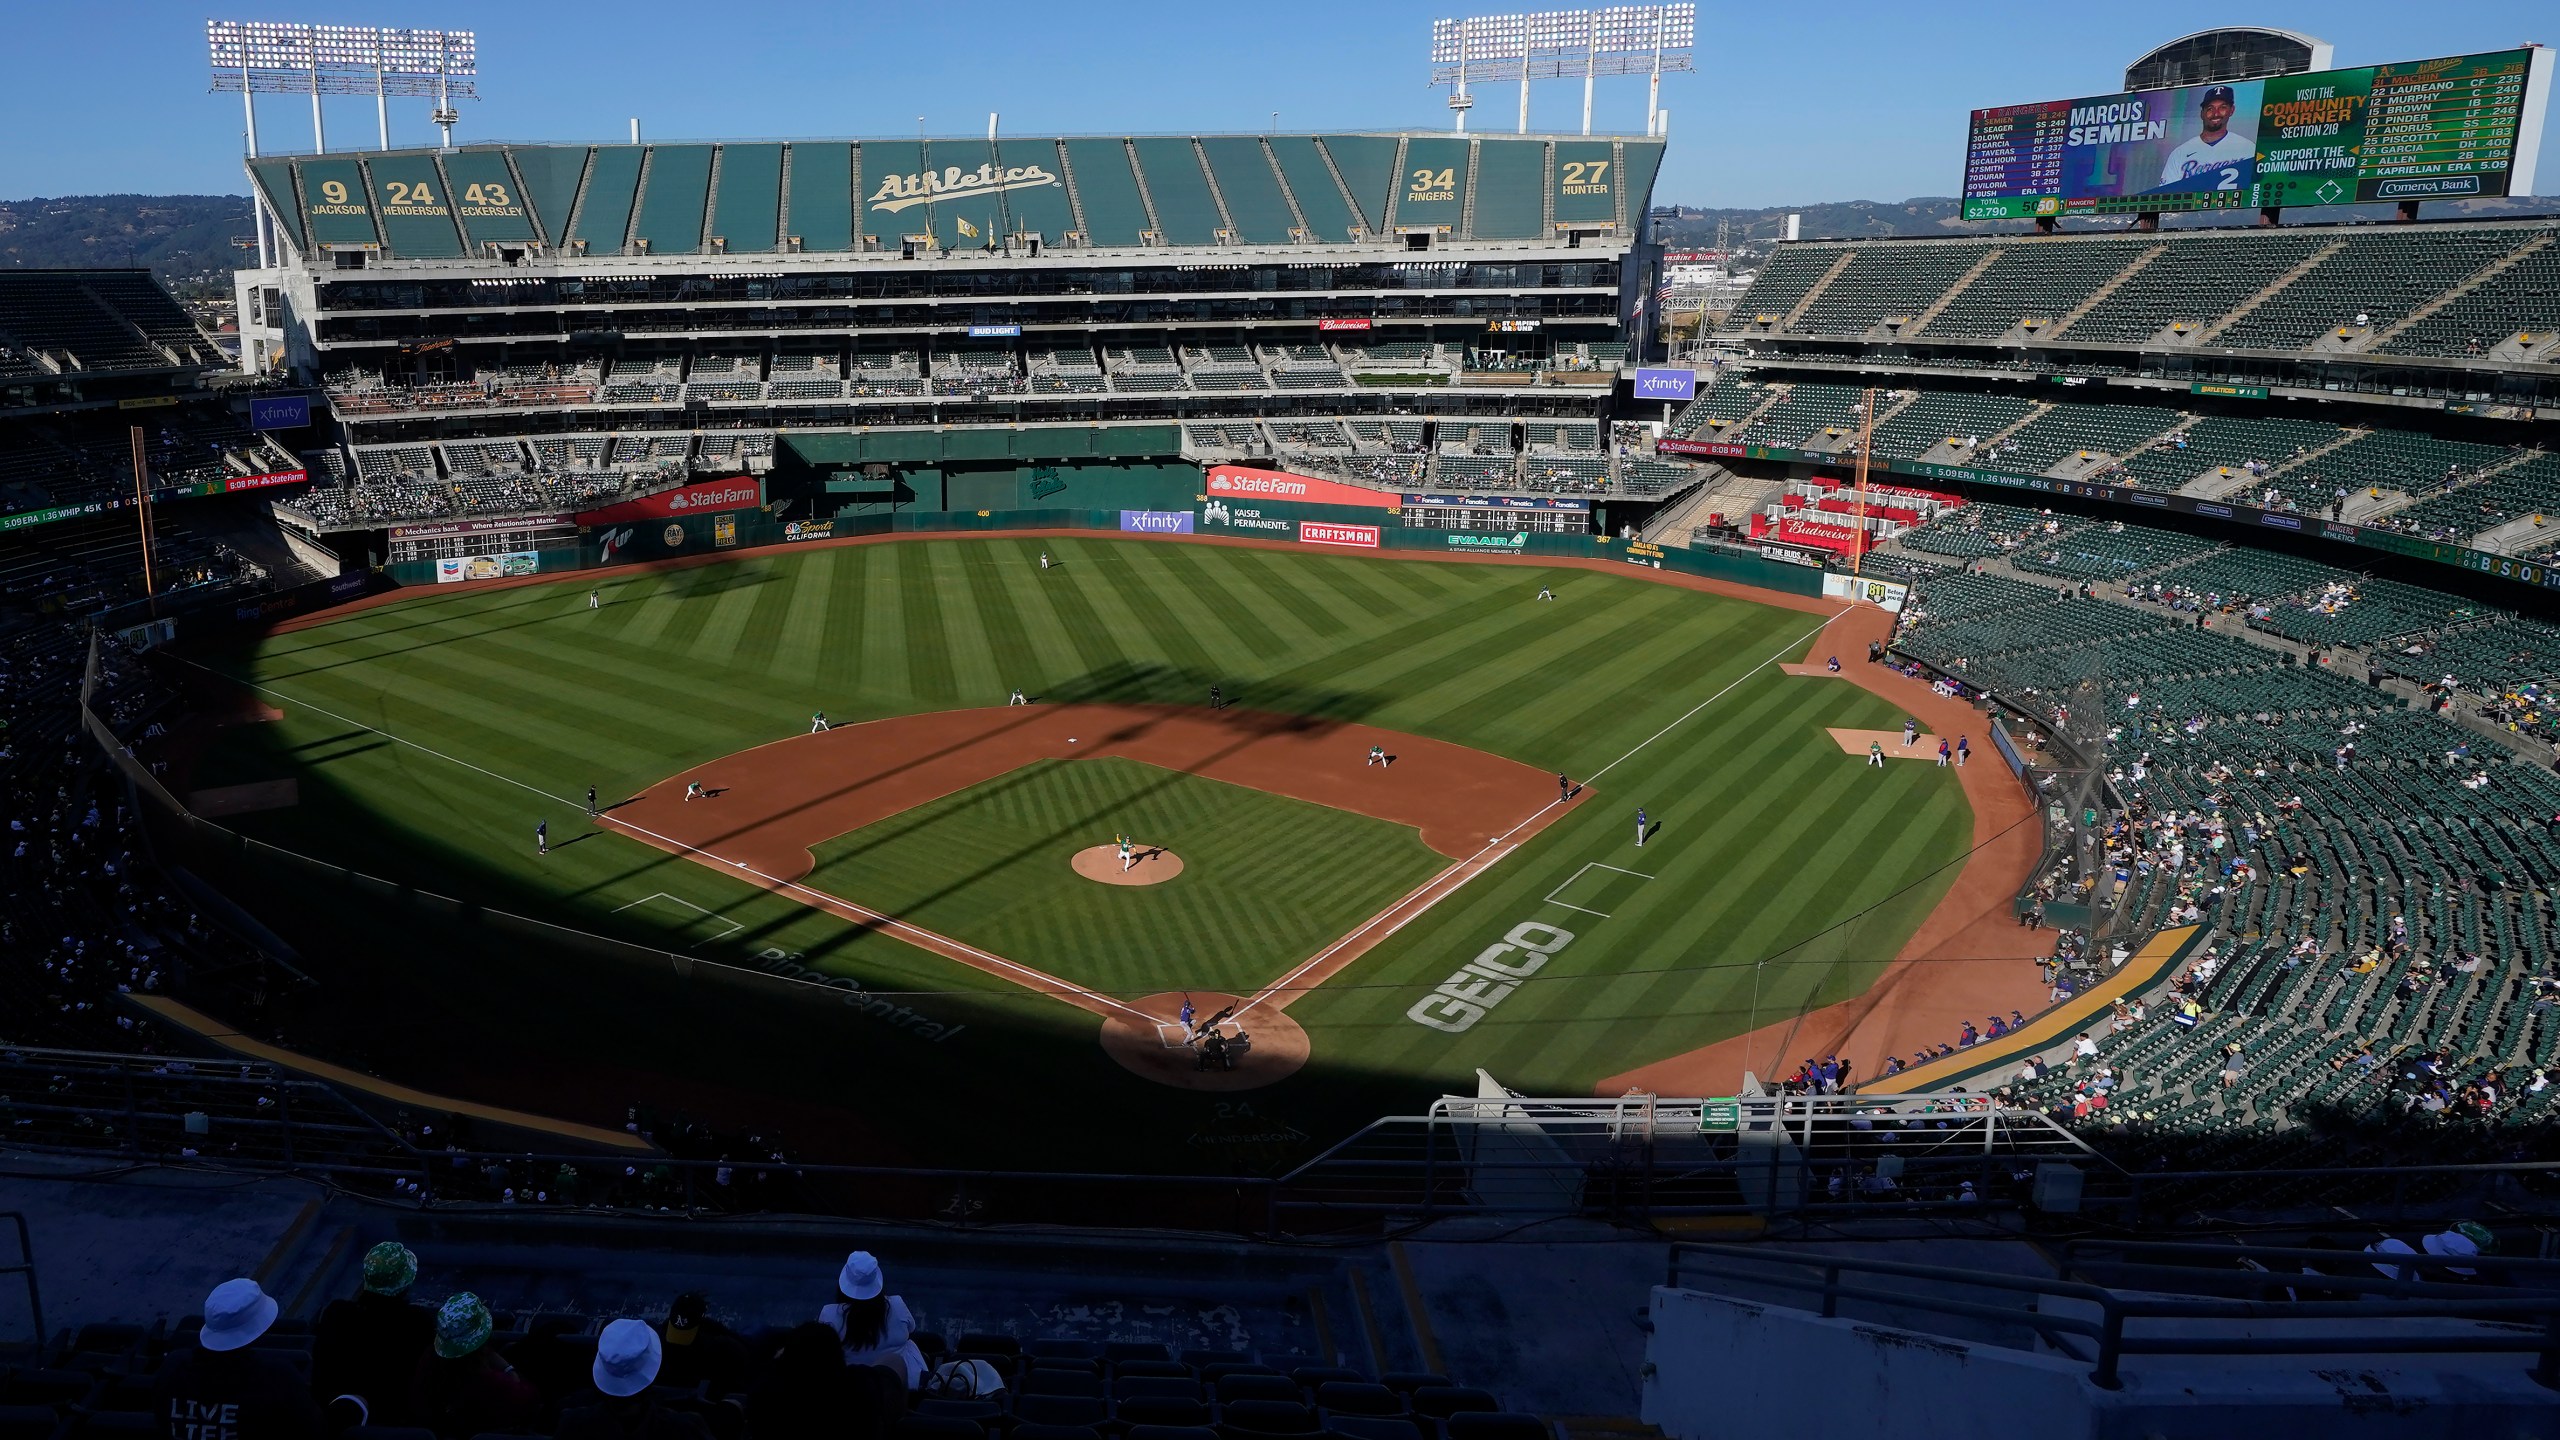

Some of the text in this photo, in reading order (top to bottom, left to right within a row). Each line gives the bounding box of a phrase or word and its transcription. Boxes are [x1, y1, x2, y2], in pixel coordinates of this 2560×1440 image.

[2390, 74, 2522, 94] LAUREANO .235
[2297, 86, 2335, 100] VISIT THE
[2388, 84, 2520, 104] MURPHY .240
[2264, 95, 2368, 116] COMMUNITY
[2387, 96, 2518, 114] BROWN .227
[1984, 117, 2014, 125] SEMIEN
[2070, 102, 2142, 126] MARCUS
[2274, 109, 2352, 126] CORNER
[2386, 106, 2516, 124] PINDER .246
[1984, 125, 2013, 133] SEAGER
[2282, 123, 2339, 139] SECTION 218
[2384, 116, 2514, 134] ANDRUS .227
[1983, 133, 2005, 141] LOWE
[2068, 120, 2166, 146] SEMIEN
[2382, 128, 2512, 144] PISCOTTY .183
[1982, 148, 2015, 156] TAVERAS
[2270, 146, 2345, 161] SUPPORT THE
[2381, 138, 2510, 154] GARCIA .400
[1980, 156, 2016, 165] CALHOUN
[2379, 149, 2508, 164] ALLEN .194
[1980, 165, 2004, 173] SMITH
[2256, 157, 2356, 173] COMMUNITY FUND
[2377, 160, 2508, 176] KAPRIELIAN ERA 5.09
[1411, 168, 1455, 192] 34
[1562, 162, 1608, 185] 27
[2217, 168, 2238, 190] 2
[322, 180, 348, 204] 9
[868, 163, 1056, 213] Athletics
[1563, 184, 1608, 194] HUNTER
[1978, 181, 2007, 189] VILORIA
[2442, 180, 2472, 190] Bank
[386, 182, 434, 204] 24
[464, 183, 510, 206] 43
[1408, 192, 1454, 201] FINGERS
[312, 205, 366, 215] JACKSON
[383, 206, 448, 216] HENDERSON
[461, 206, 523, 216] ECKERSLEY
[1969, 206, 2007, 218] $2,790
[1322, 320, 1369, 330] Budweiser
[1643, 376, 1686, 392] xfinity
[260, 406, 301, 422] xfinity
[1826, 456, 1836, 464] 32
[248, 479, 258, 487] PM
[1938, 469, 1957, 478] 5.09
[1958, 472, 1976, 480] ERA
[2000, 476, 2026, 486] WHIP
[22, 516, 38, 524] ERA
[58, 508, 80, 518] WHIP
[1132, 509, 1182, 531] xfinity
[1234, 508, 1261, 518] KAISER
[494, 519, 536, 528] Relationships
[800, 521, 834, 533] Sports
[1234, 519, 1289, 530] PERMANENTE
[1787, 520, 1854, 540] Budweiser
[2327, 523, 2354, 534] RANGERS
[405, 527, 441, 536] Mechanics
[787, 531, 830, 540] CALIFORNIA
[1305, 528, 1371, 542] CRAFTSMAN
[2322, 530, 2356, 542] ATHLETICS
[1772, 548, 1783, 556] THE
[1784, 549, 1800, 558] BUDS
[331, 578, 362, 593] Southwest
[1830, 575, 1845, 583] 330
[1869, 583, 1885, 597] 811
[1406, 922, 1576, 1033] GEICO
[1198, 1133, 1296, 1144] HENDERSON
[171, 1398, 238, 1424] LIVE
